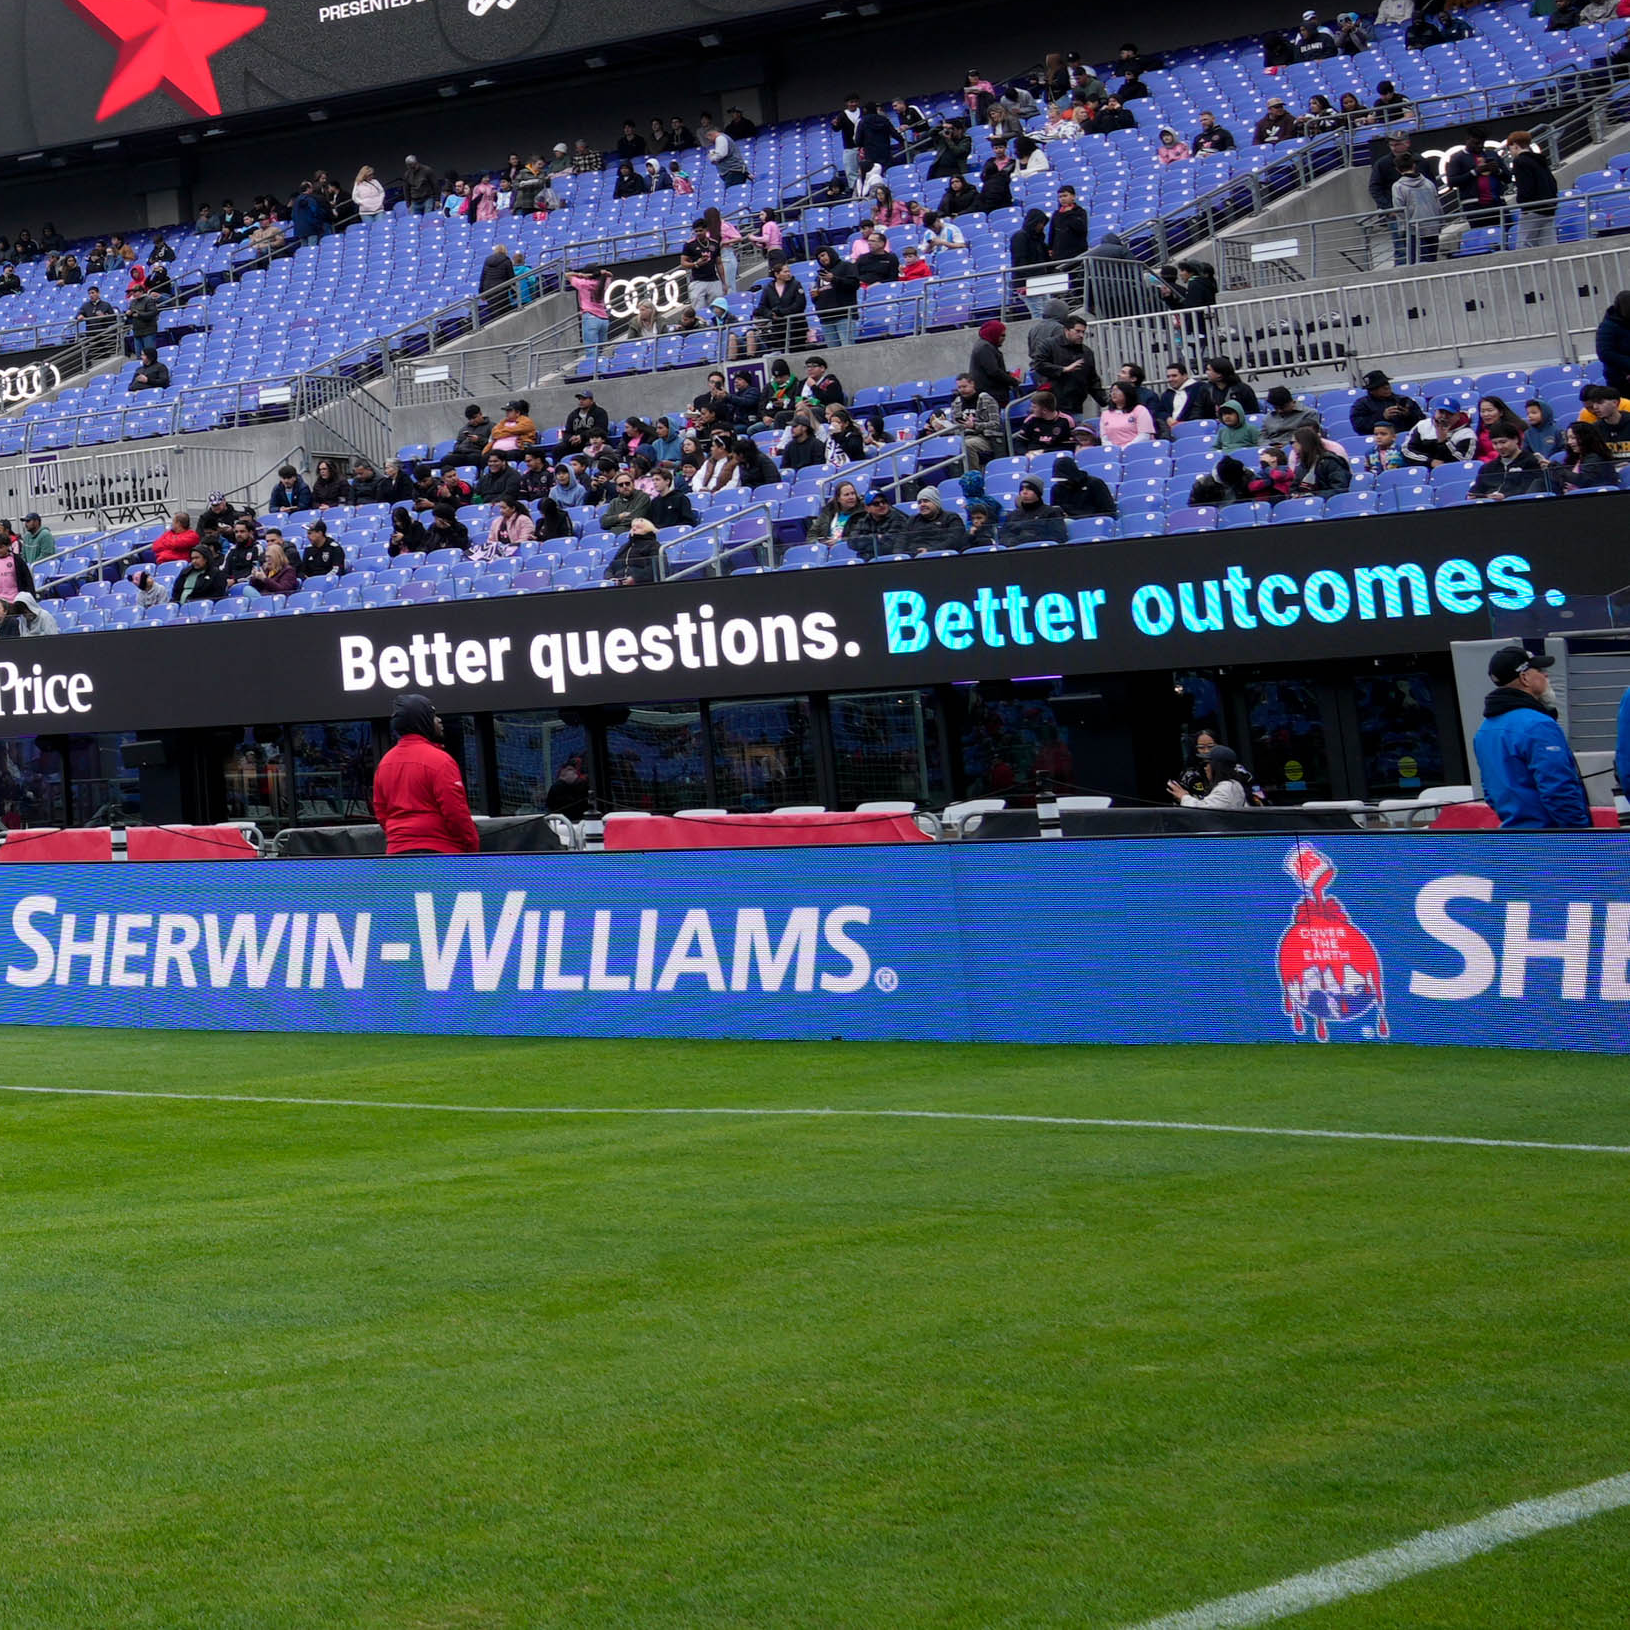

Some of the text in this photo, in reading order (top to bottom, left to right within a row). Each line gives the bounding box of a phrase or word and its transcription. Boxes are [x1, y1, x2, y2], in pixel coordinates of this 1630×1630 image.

[340, 554, 1565, 693] Better questions. Better outcomes.
[1312, 939, 1339, 949] THE
[1303, 950, 1350, 961] EARTH
